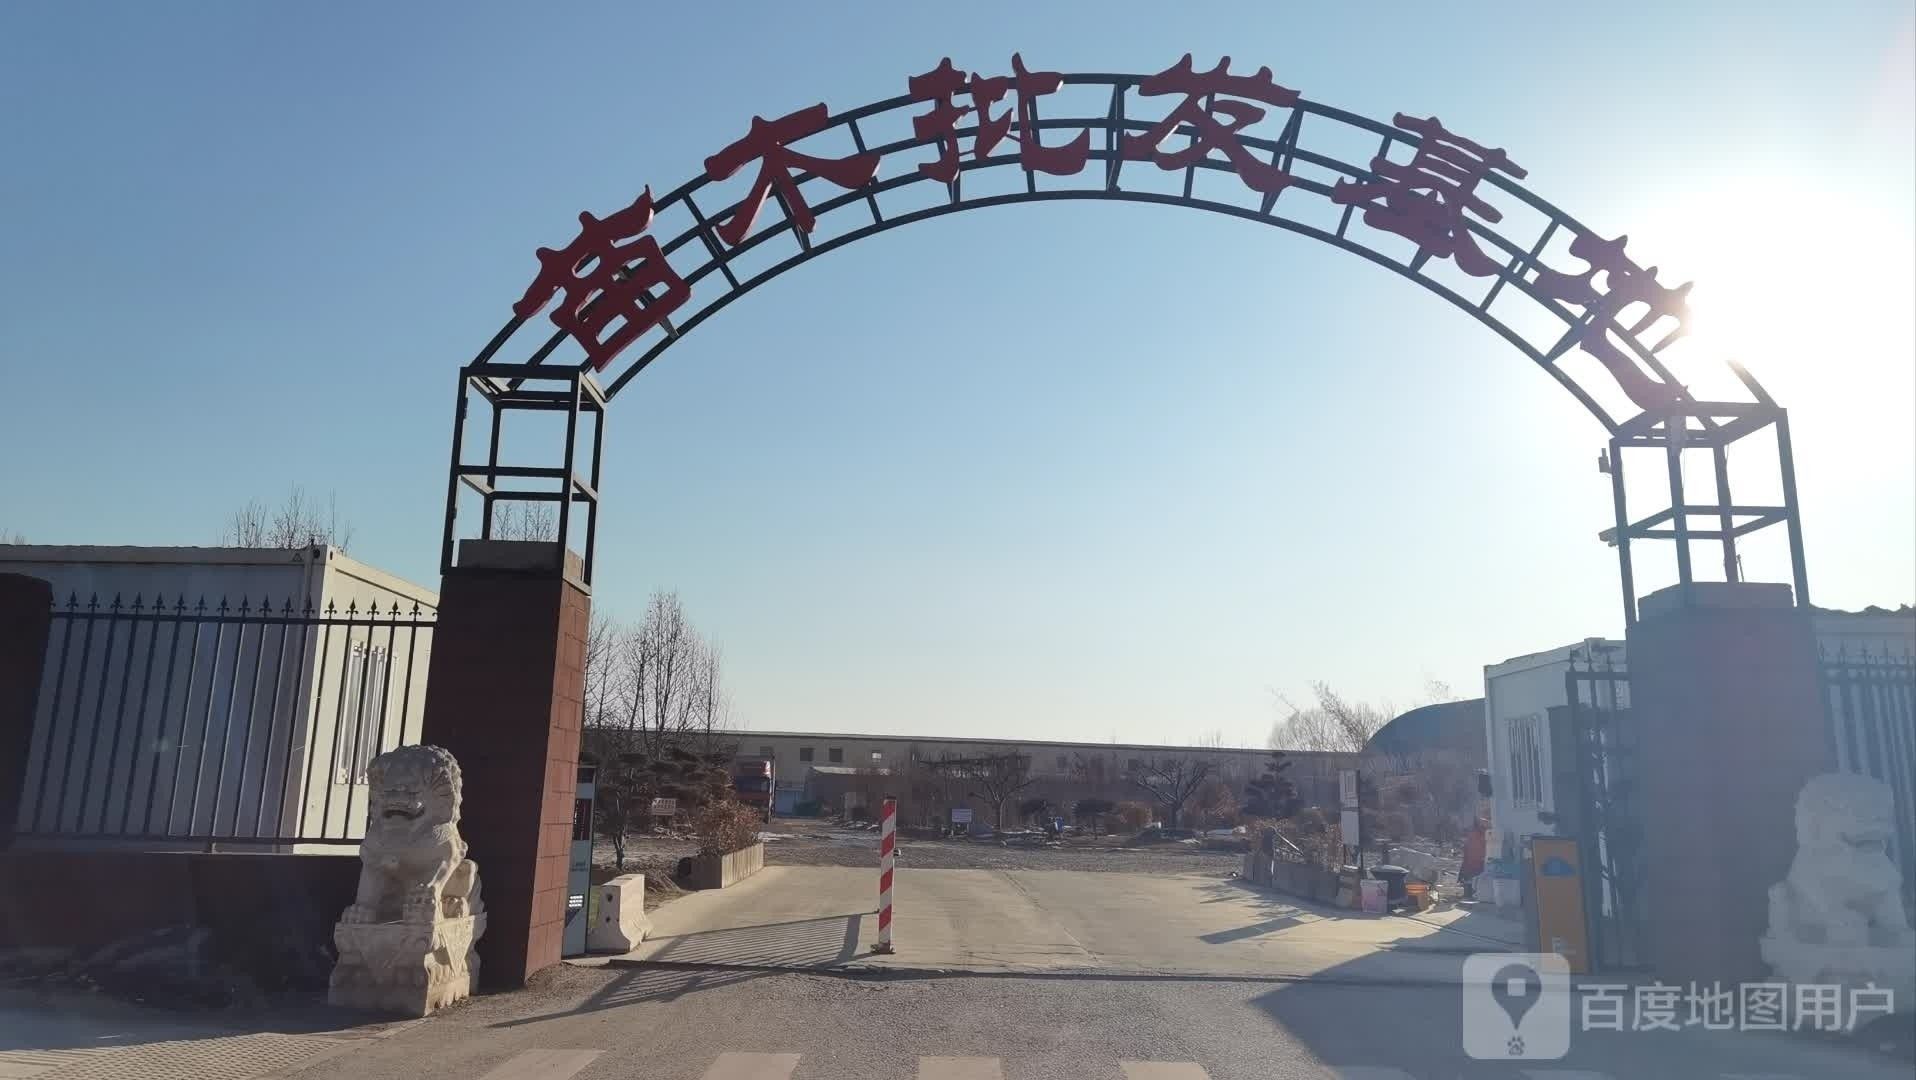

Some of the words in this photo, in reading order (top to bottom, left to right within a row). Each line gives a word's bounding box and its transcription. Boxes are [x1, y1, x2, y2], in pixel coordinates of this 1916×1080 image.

[513, 51, 1694, 411] 苗木批发基地
